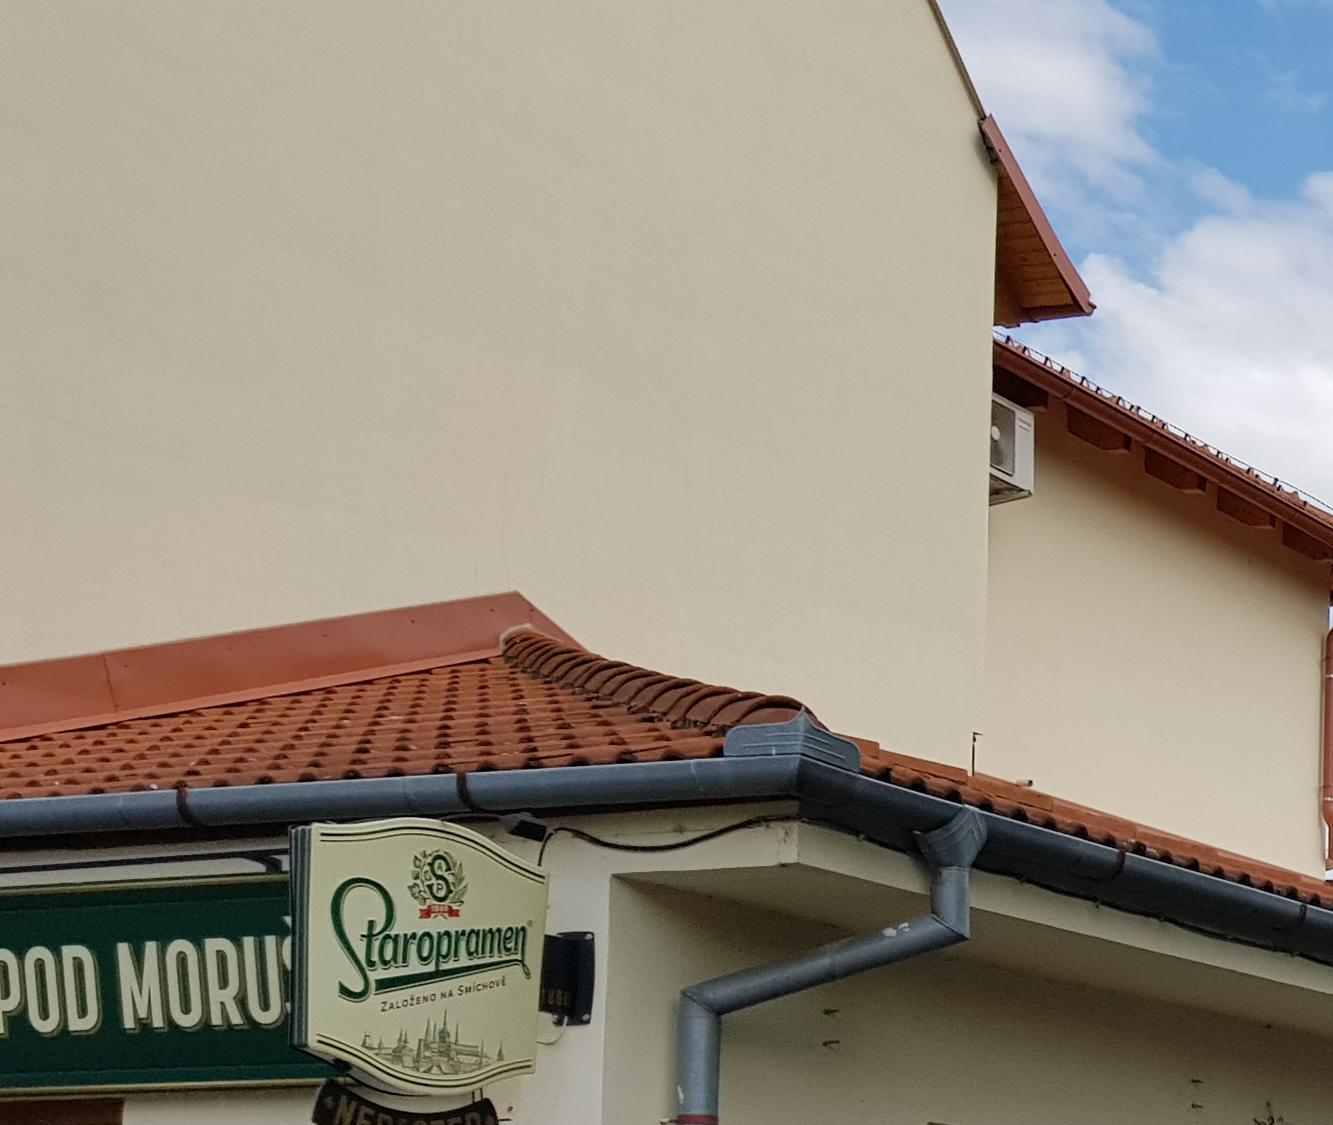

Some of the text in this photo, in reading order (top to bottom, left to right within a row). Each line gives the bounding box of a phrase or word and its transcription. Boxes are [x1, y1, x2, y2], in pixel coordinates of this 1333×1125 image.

[0, 916, 292, 1034] POD MORU
[331, 877, 531, 1003] Staropramen
[440, 989, 453, 1000] NA
